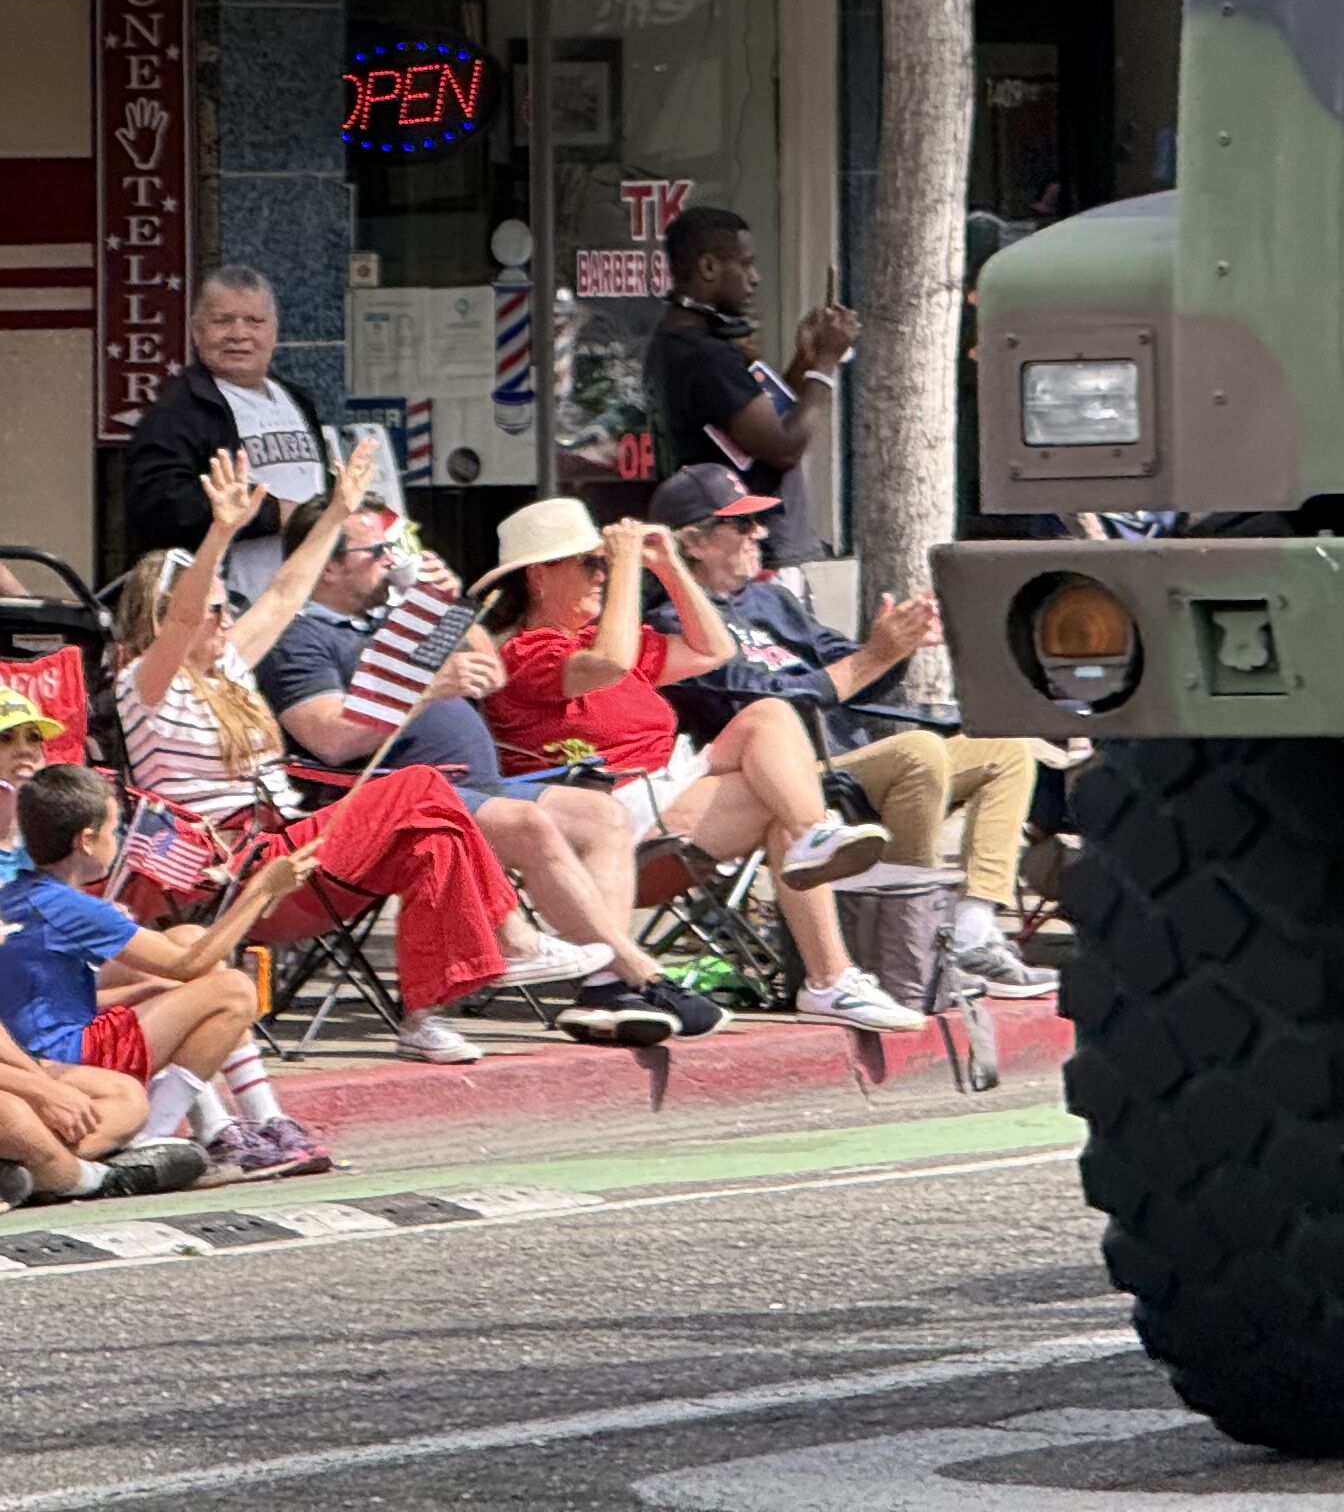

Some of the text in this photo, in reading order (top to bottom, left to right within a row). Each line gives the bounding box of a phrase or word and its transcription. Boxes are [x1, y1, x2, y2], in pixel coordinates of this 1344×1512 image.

[620, 180, 694, 241] TK
[121, 175, 166, 403] TELLER
[576, 249, 648, 297] BARBER
